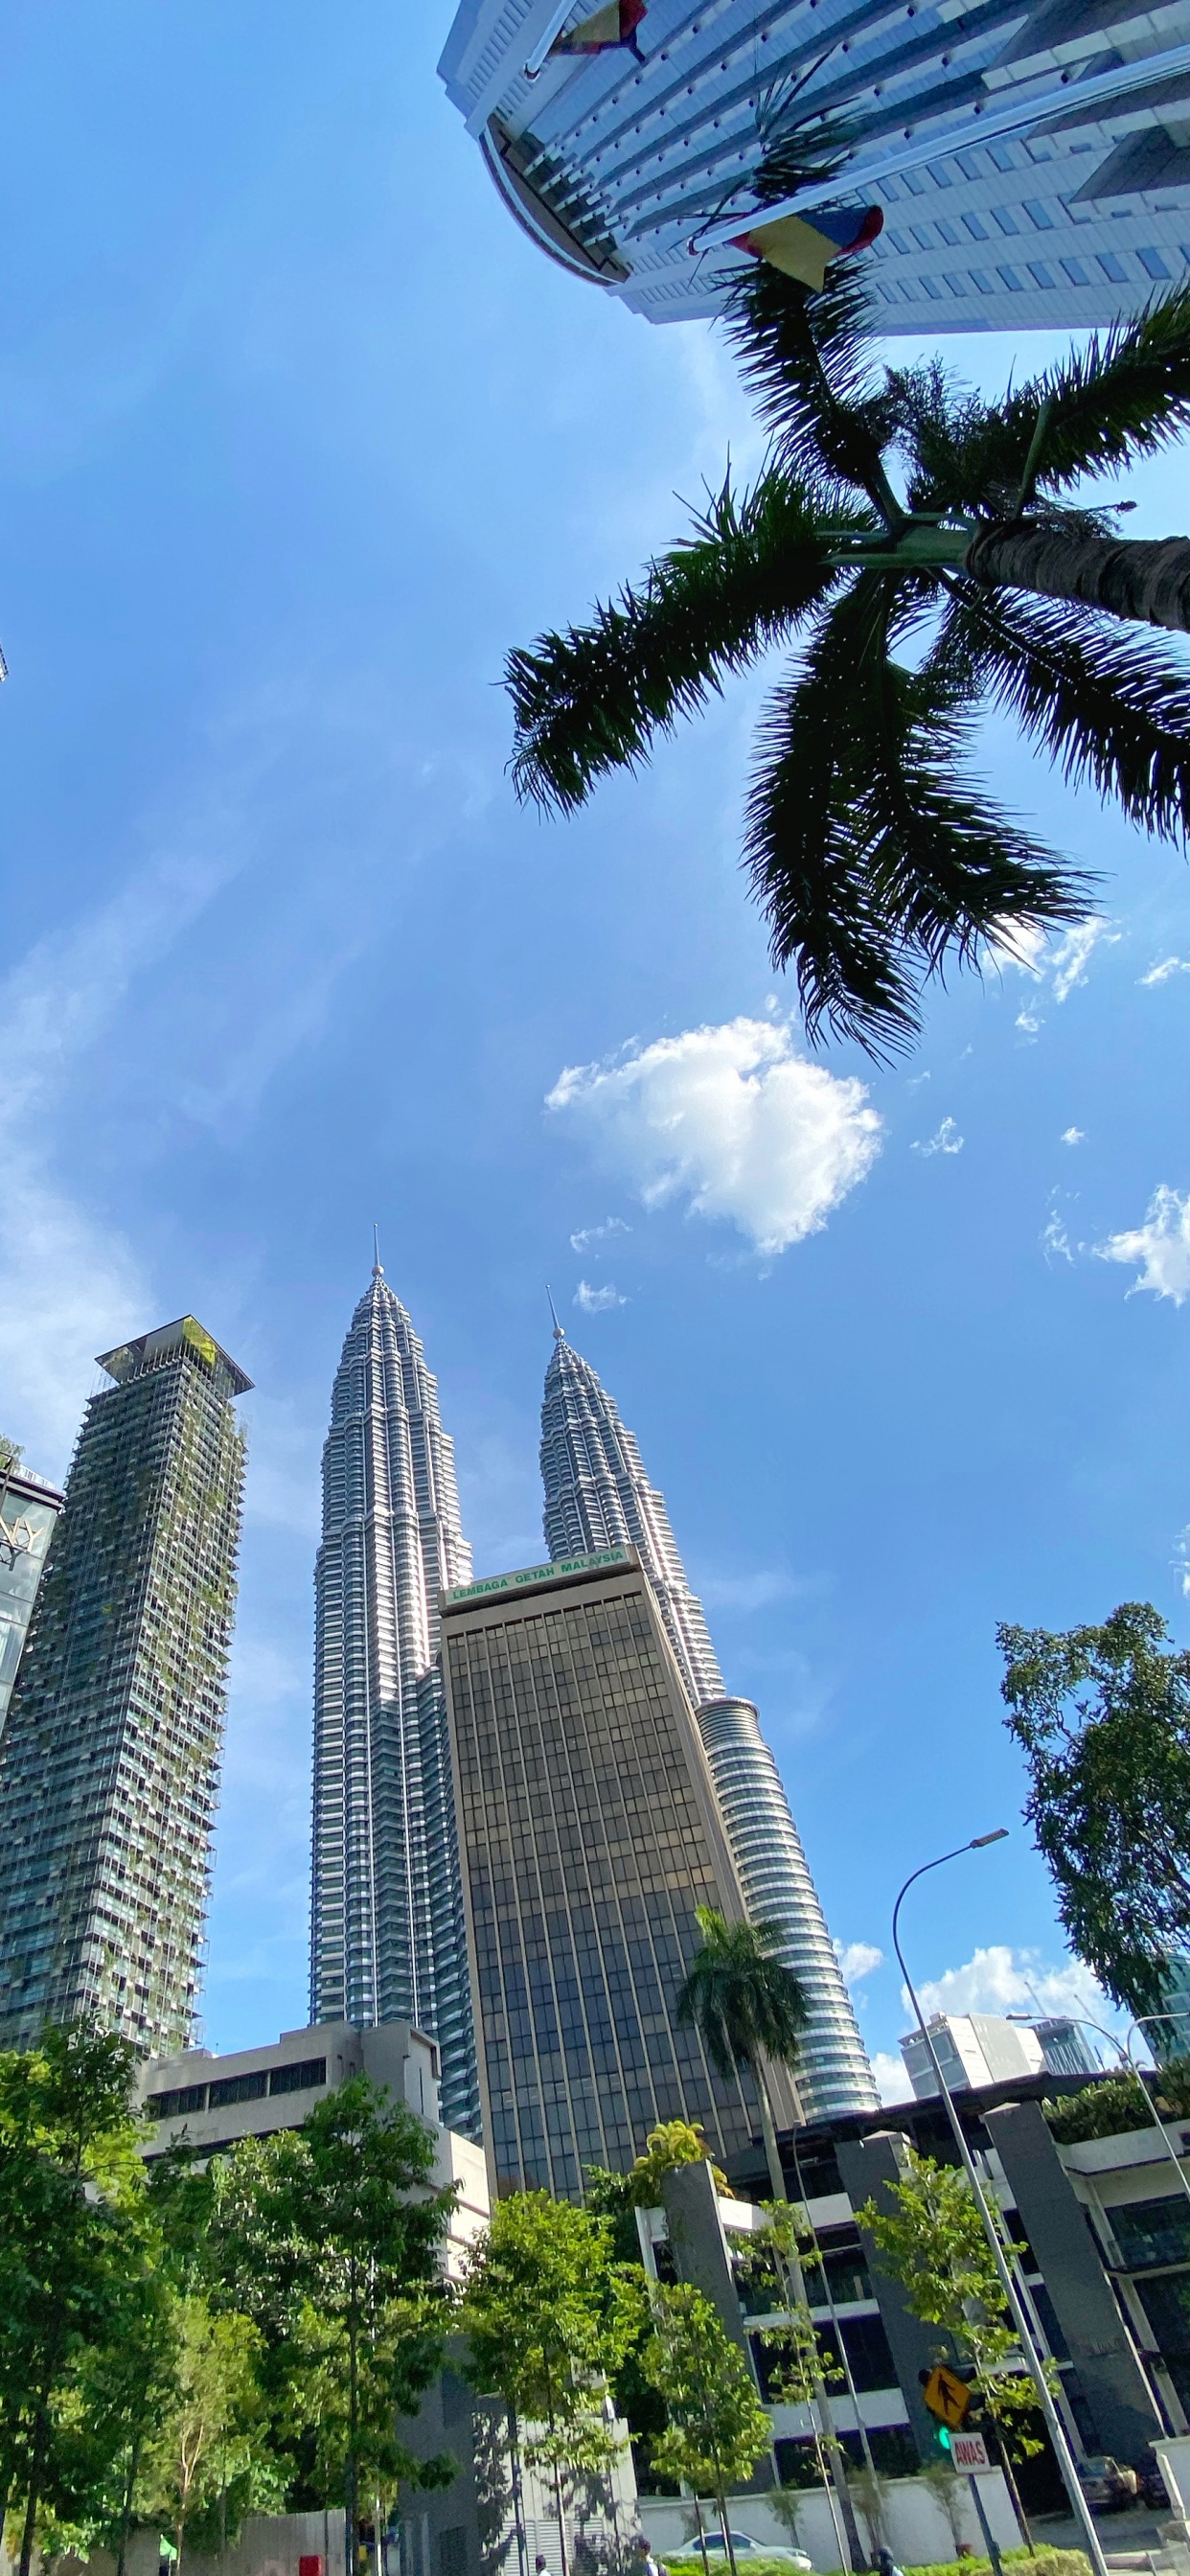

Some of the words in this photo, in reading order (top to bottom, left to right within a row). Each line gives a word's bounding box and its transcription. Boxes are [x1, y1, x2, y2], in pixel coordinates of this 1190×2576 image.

[452, 1578, 508, 1599] LEMBAGA
[515, 1567, 555, 1584] GETAH
[561, 1551, 623, 1573] MALAYSIA
[954, 2441, 986, 2466] AWAS
